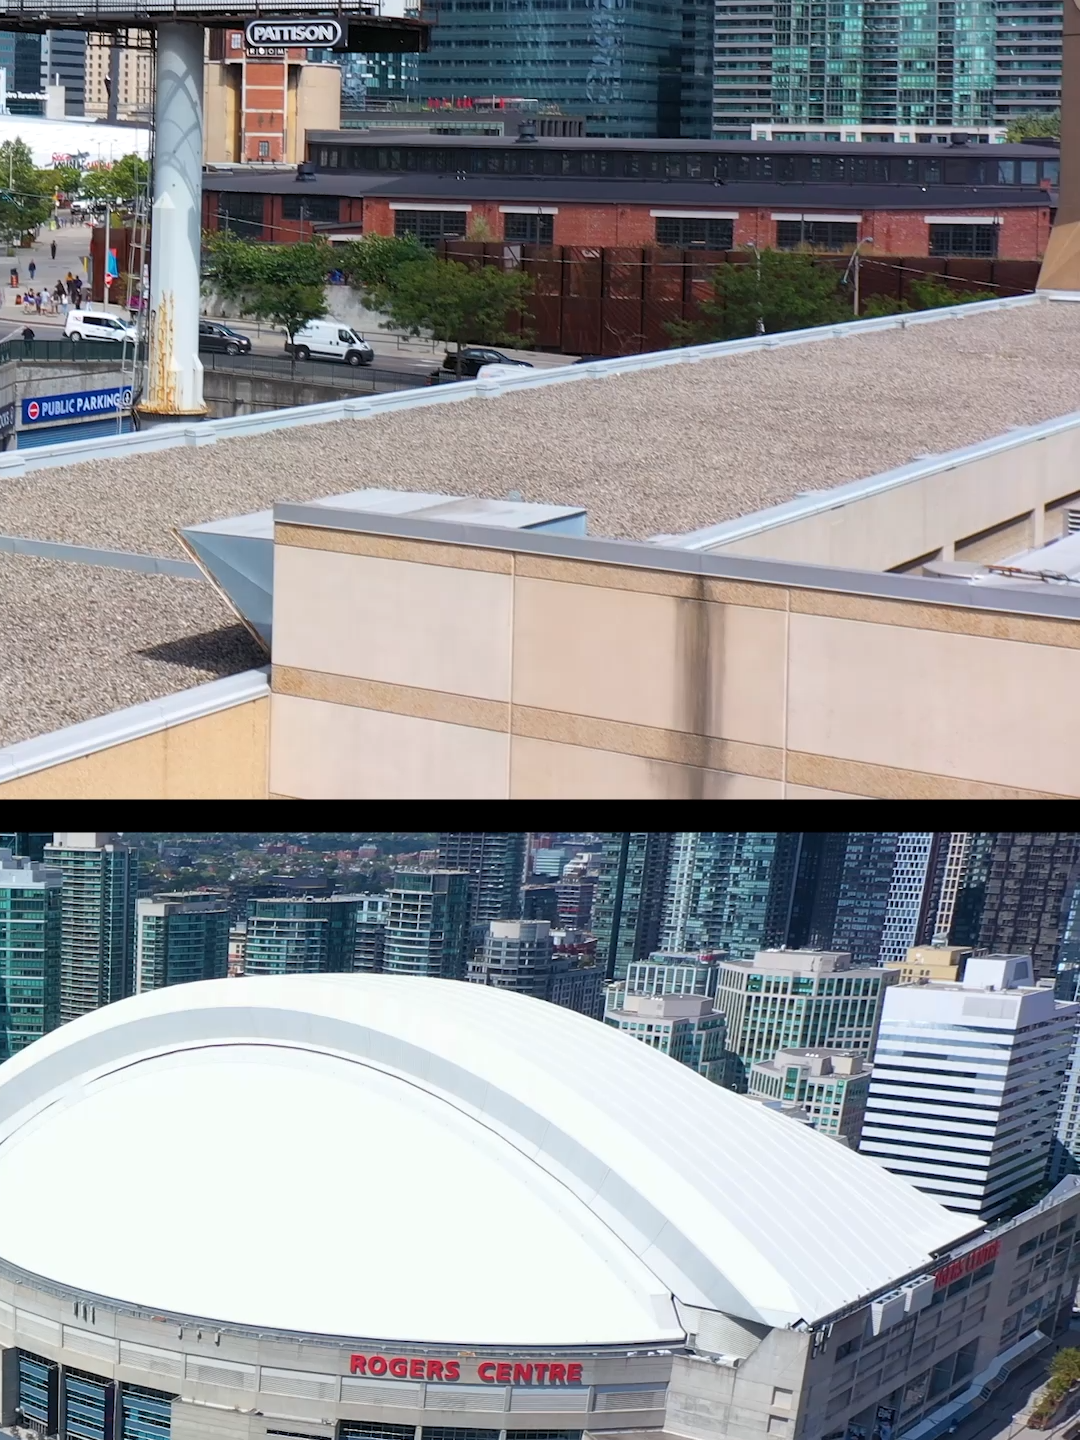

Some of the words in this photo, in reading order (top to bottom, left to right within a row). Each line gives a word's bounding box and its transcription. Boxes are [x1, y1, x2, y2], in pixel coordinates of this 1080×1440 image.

[254, 26, 334, 41] PATTISON
[42, 400, 75, 416] PUBLIC
[77, 393, 120, 411] PARKING
[350, 1354, 460, 1381] ROGERS
[478, 1362, 583, 1383] CENTRE
